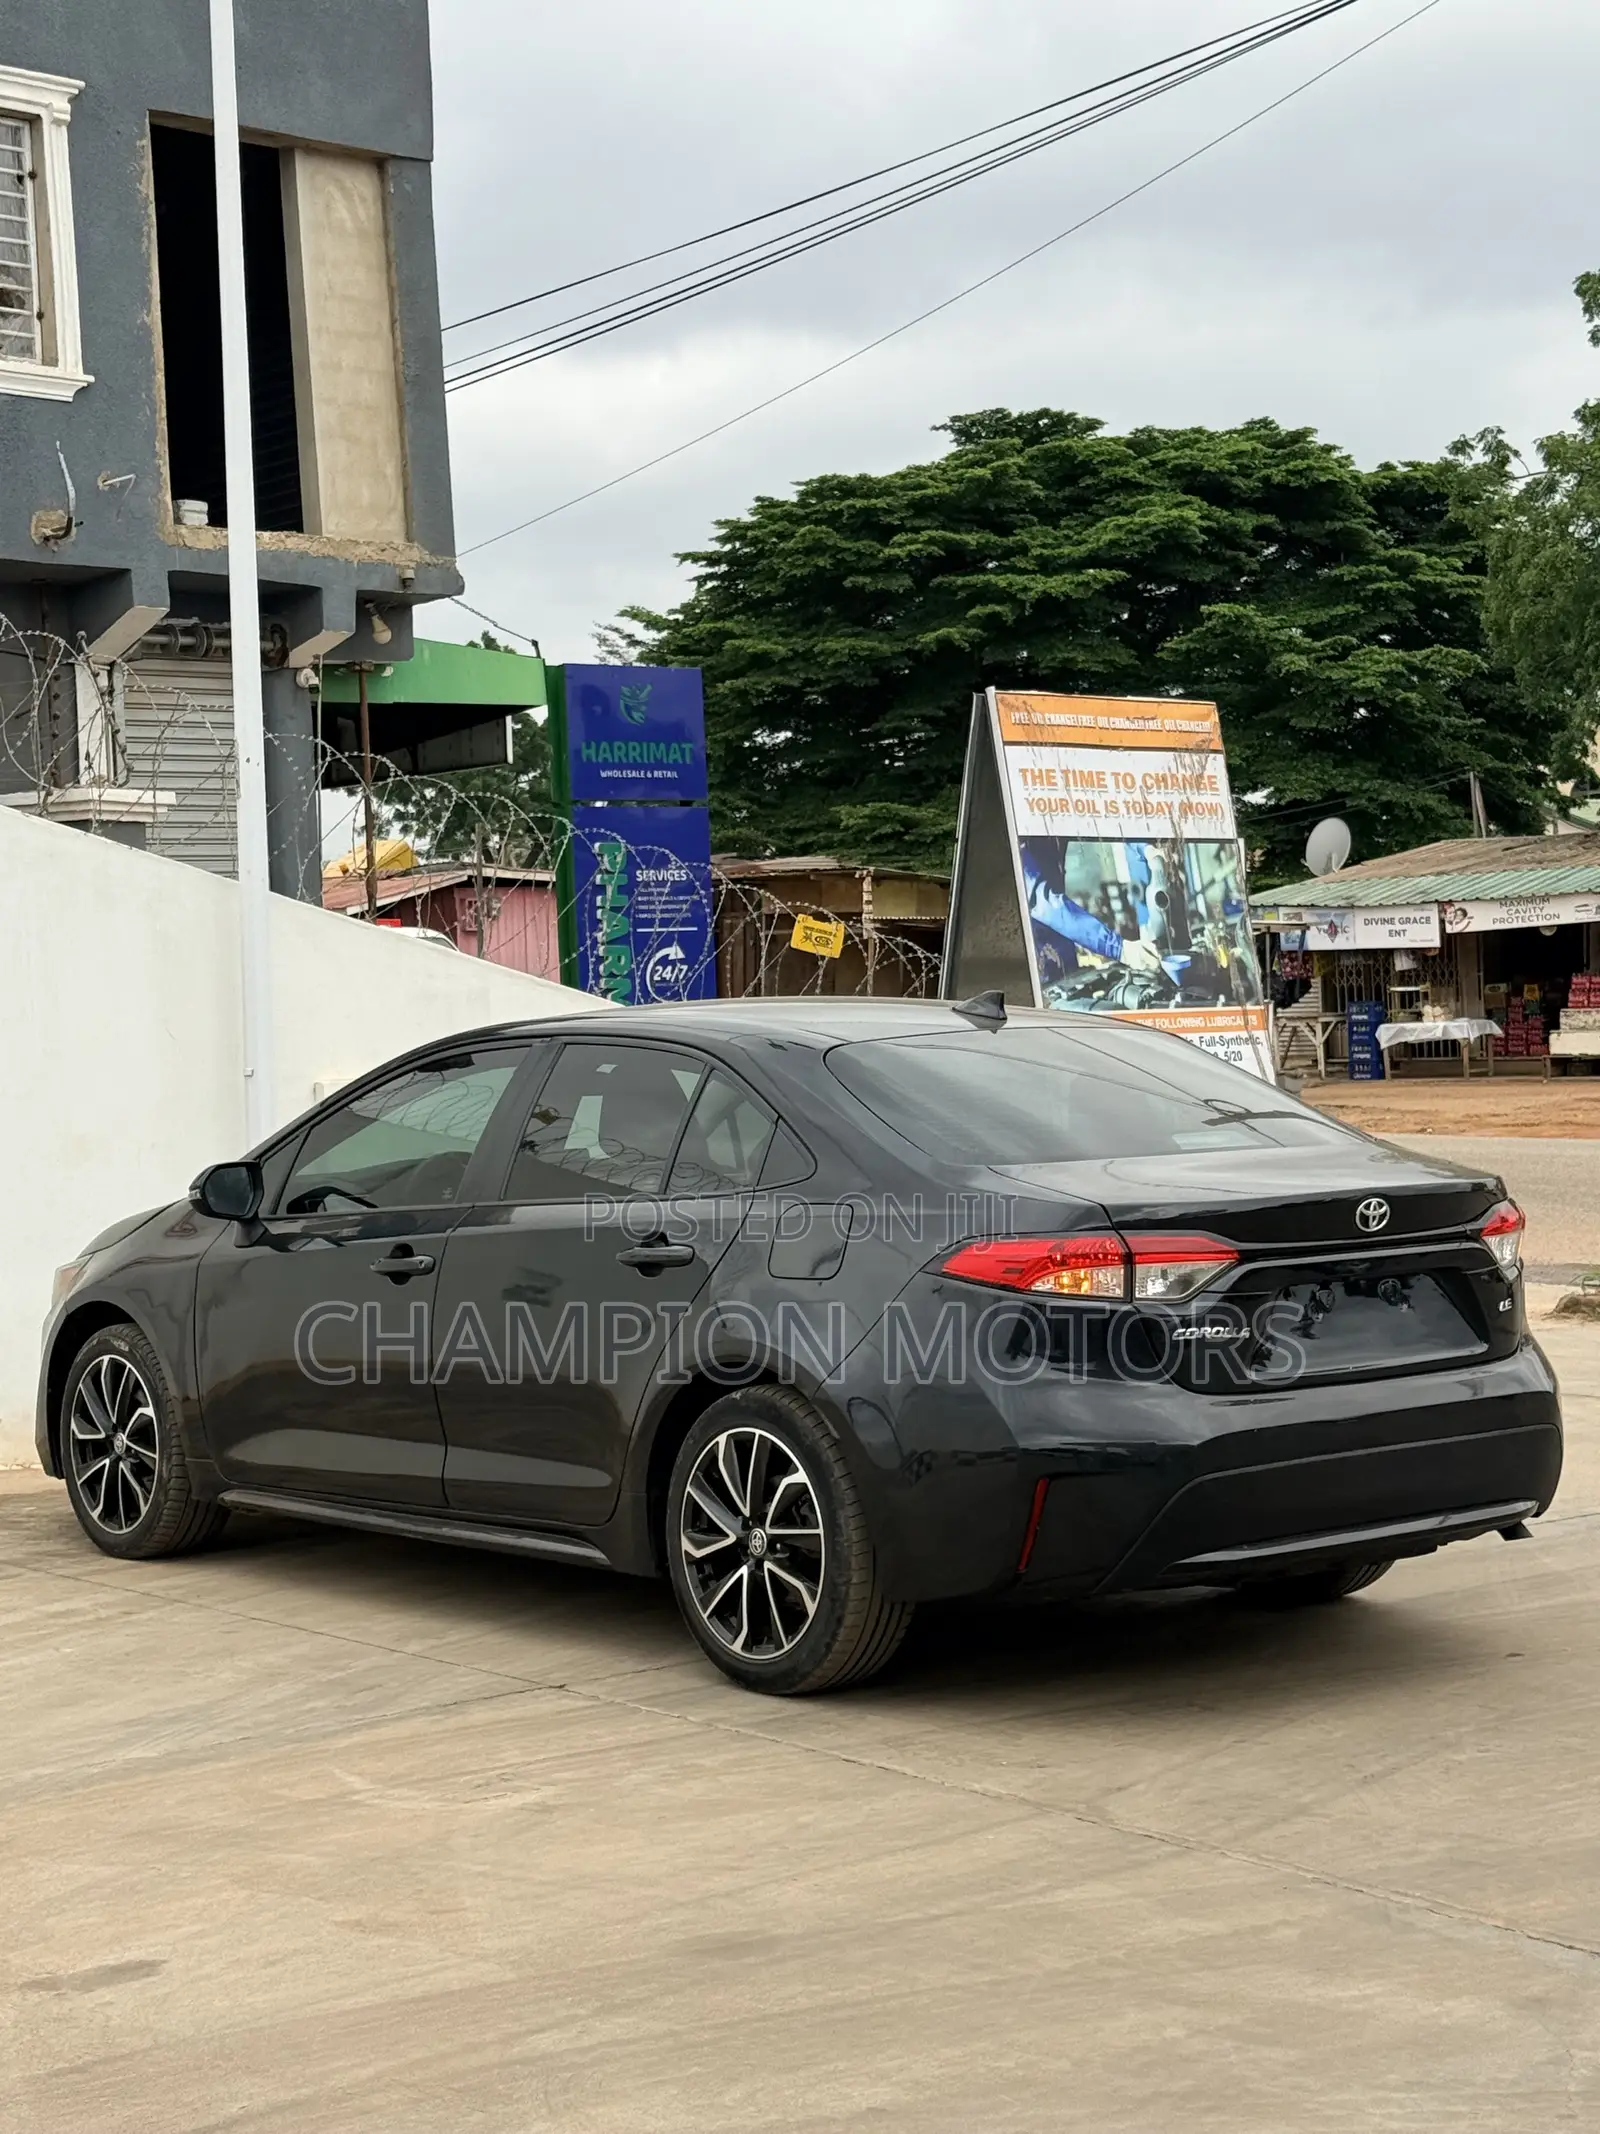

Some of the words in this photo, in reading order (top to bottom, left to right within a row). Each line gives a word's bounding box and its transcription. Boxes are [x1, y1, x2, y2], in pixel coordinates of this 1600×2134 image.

[581, 741, 694, 765] HARRIMAT
[600, 769, 645, 779] WHOLESALE
[646, 770, 652, 779] &
[653, 770, 679, 779] RETAIL
[1019, 767, 1058, 788] THE
[1061, 769, 1108, 790] TIME
[1111, 772, 1136, 791] TO
[1141, 772, 1220, 793] CHANGE
[1024, 797, 1071, 815] YOUR
[1074, 799, 1102, 816] OIL
[1104, 800, 1121, 816] IS
[1123, 800, 1174, 817] TODAY
[635, 869, 688, 882] SERVICES
[1499, 897, 1551, 909] MAXIMUM
[1506, 906, 1545, 916] CAVITY
[1363, 917, 1396, 926] DIVINE
[1398, 916, 1432, 925] GRACE
[1492, 913, 1561, 925] PROTECTION
[1388, 929, 1407, 938] ENT
[653, 964, 689, 982] 24/7
[1155, 1015, 1205, 1029] FOLLOWING
[1499, 1298, 1513, 1312] LE
[1172, 1326, 1251, 1341] COROLLA
